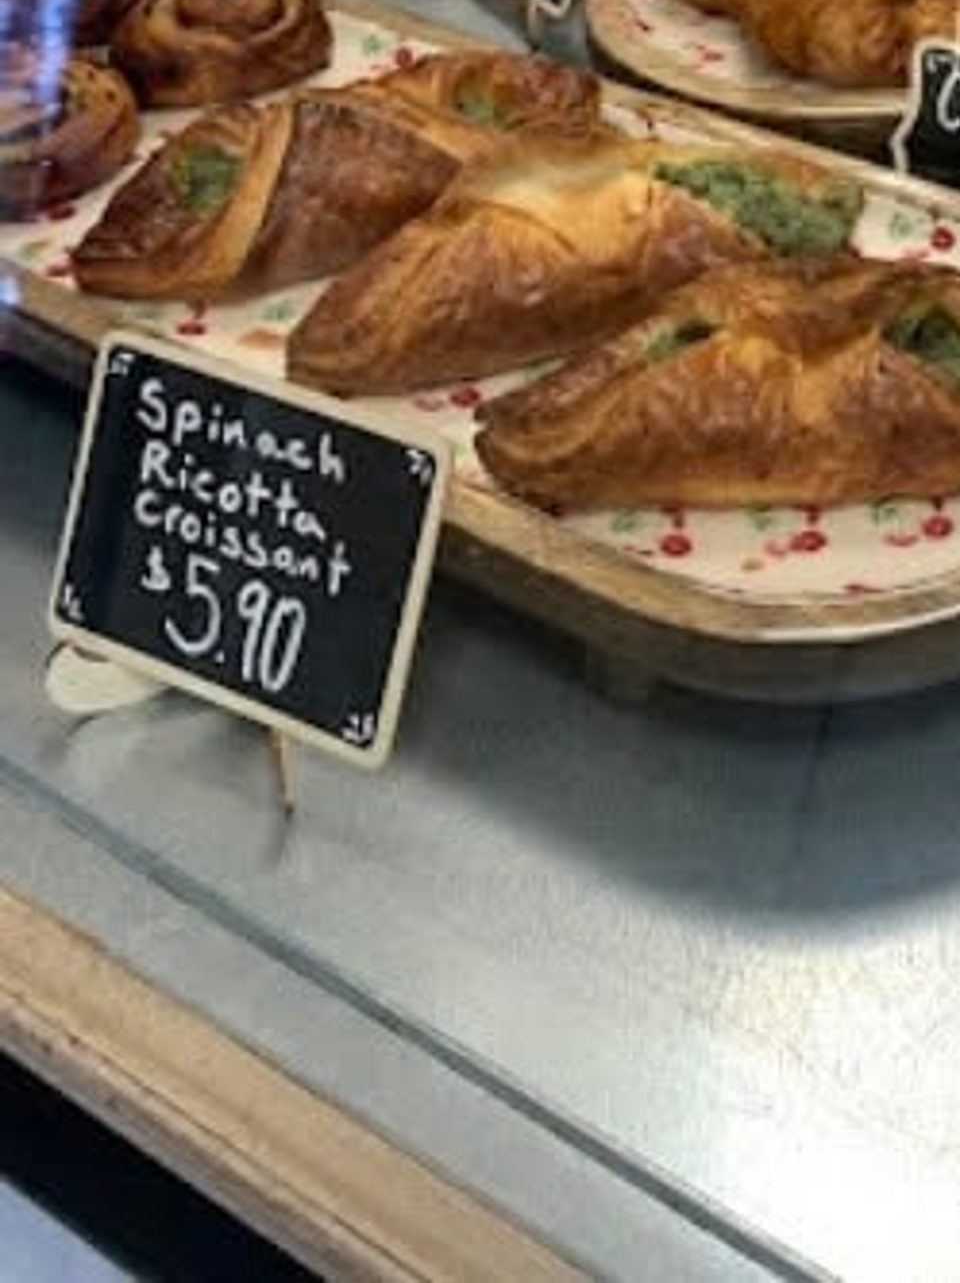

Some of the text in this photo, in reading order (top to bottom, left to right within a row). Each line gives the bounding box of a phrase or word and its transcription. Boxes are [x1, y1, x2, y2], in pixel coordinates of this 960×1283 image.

[137, 378, 344, 483] Spinach
[140, 441, 326, 541] Ricotta
[141, 545, 306, 692] $5.90
